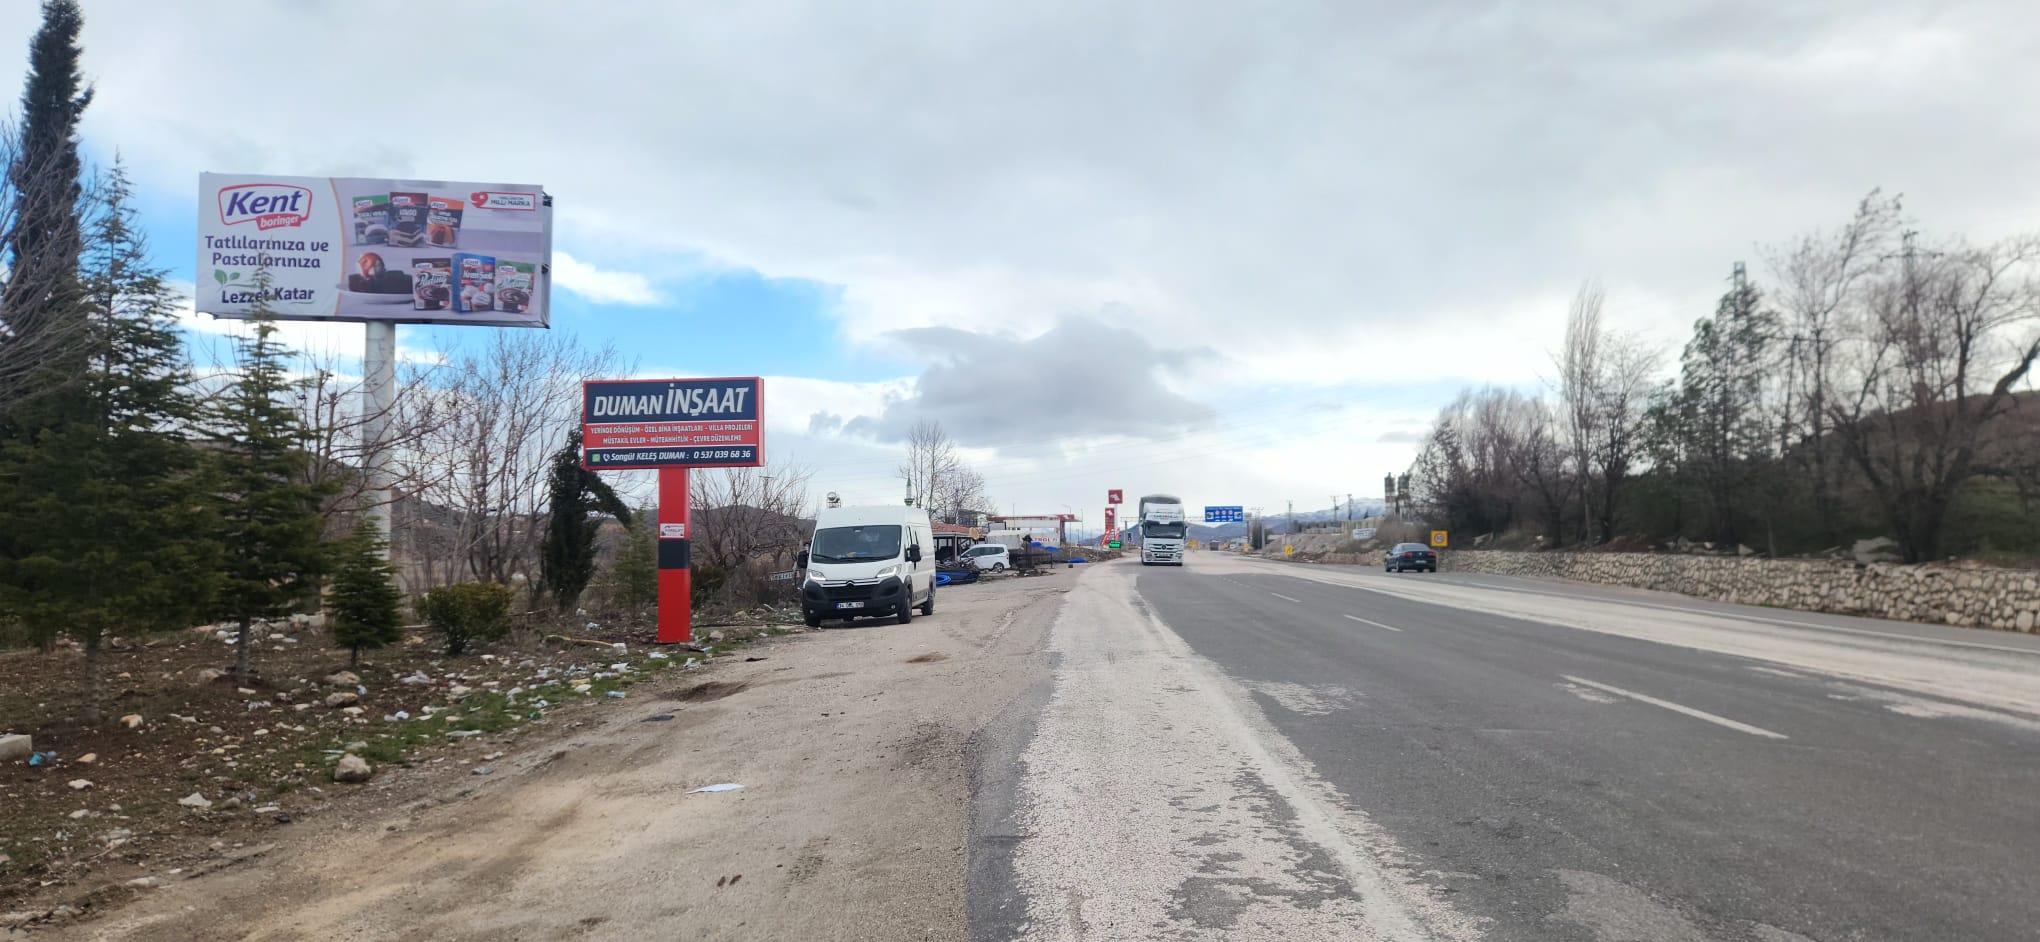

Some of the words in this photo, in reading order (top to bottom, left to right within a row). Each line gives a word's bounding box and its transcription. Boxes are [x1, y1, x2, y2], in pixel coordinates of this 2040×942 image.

[226, 191, 302, 216] Kent
[205, 235, 305, 250] Tatlılarınıza
[311, 241, 329, 252] ve
[212, 252, 321, 268] Pastalarınıza
[222, 290, 270, 303] Lezzet
[274, 287, 315, 301] Katar
[593, 395, 664, 416] DUMAN
[665, 383, 749, 416] İNŞAAT
[611, 452, 635, 462] Songül
[636, 452, 657, 462] KELEŞ
[658, 451, 685, 460] DUMAN
[693, 451, 699, 459] 0
[700, 450, 713, 459] 537
[714, 450, 729, 459] 039
[730, 450, 740, 458] 68
[741, 450, 751, 458] 36
